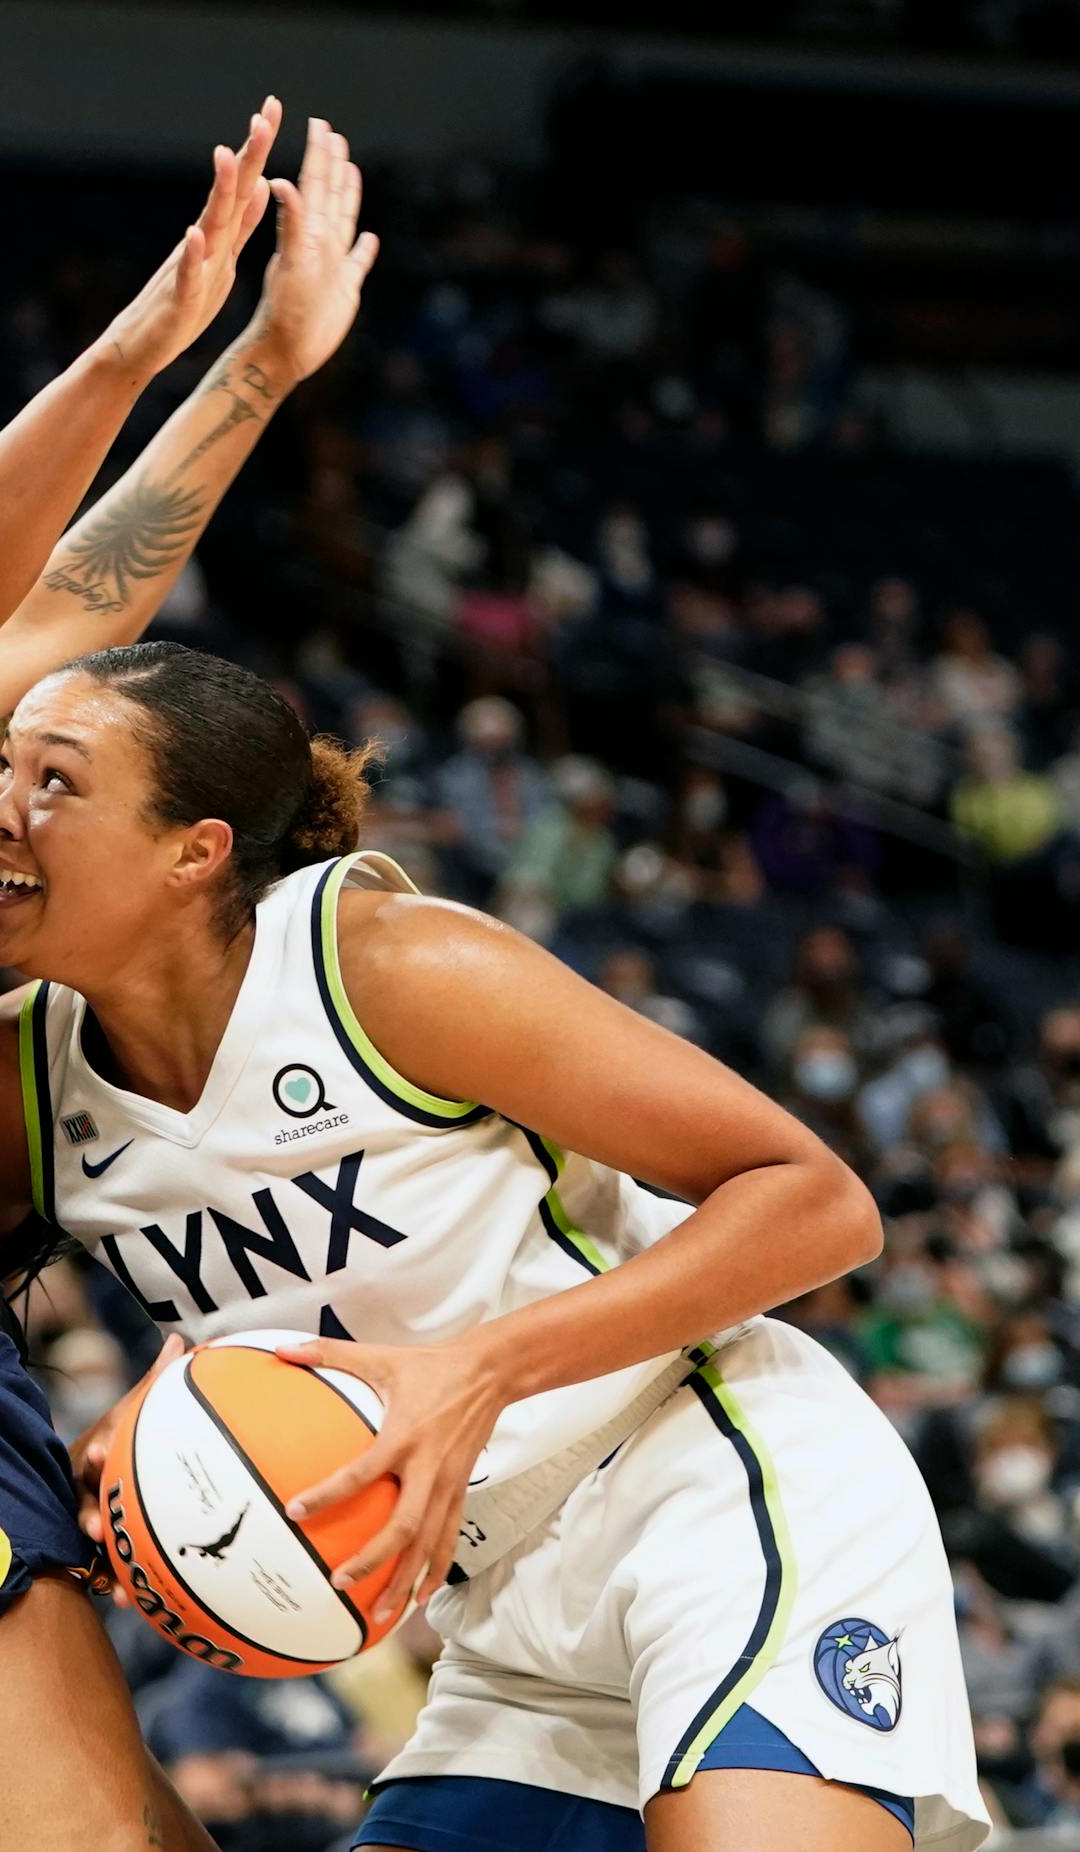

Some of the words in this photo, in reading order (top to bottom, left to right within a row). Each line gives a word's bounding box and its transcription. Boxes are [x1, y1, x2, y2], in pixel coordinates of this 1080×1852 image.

[274, 1113, 350, 1146] sharecare
[100, 1149, 408, 1322] LYNX
[107, 1477, 244, 1672] Wilson
